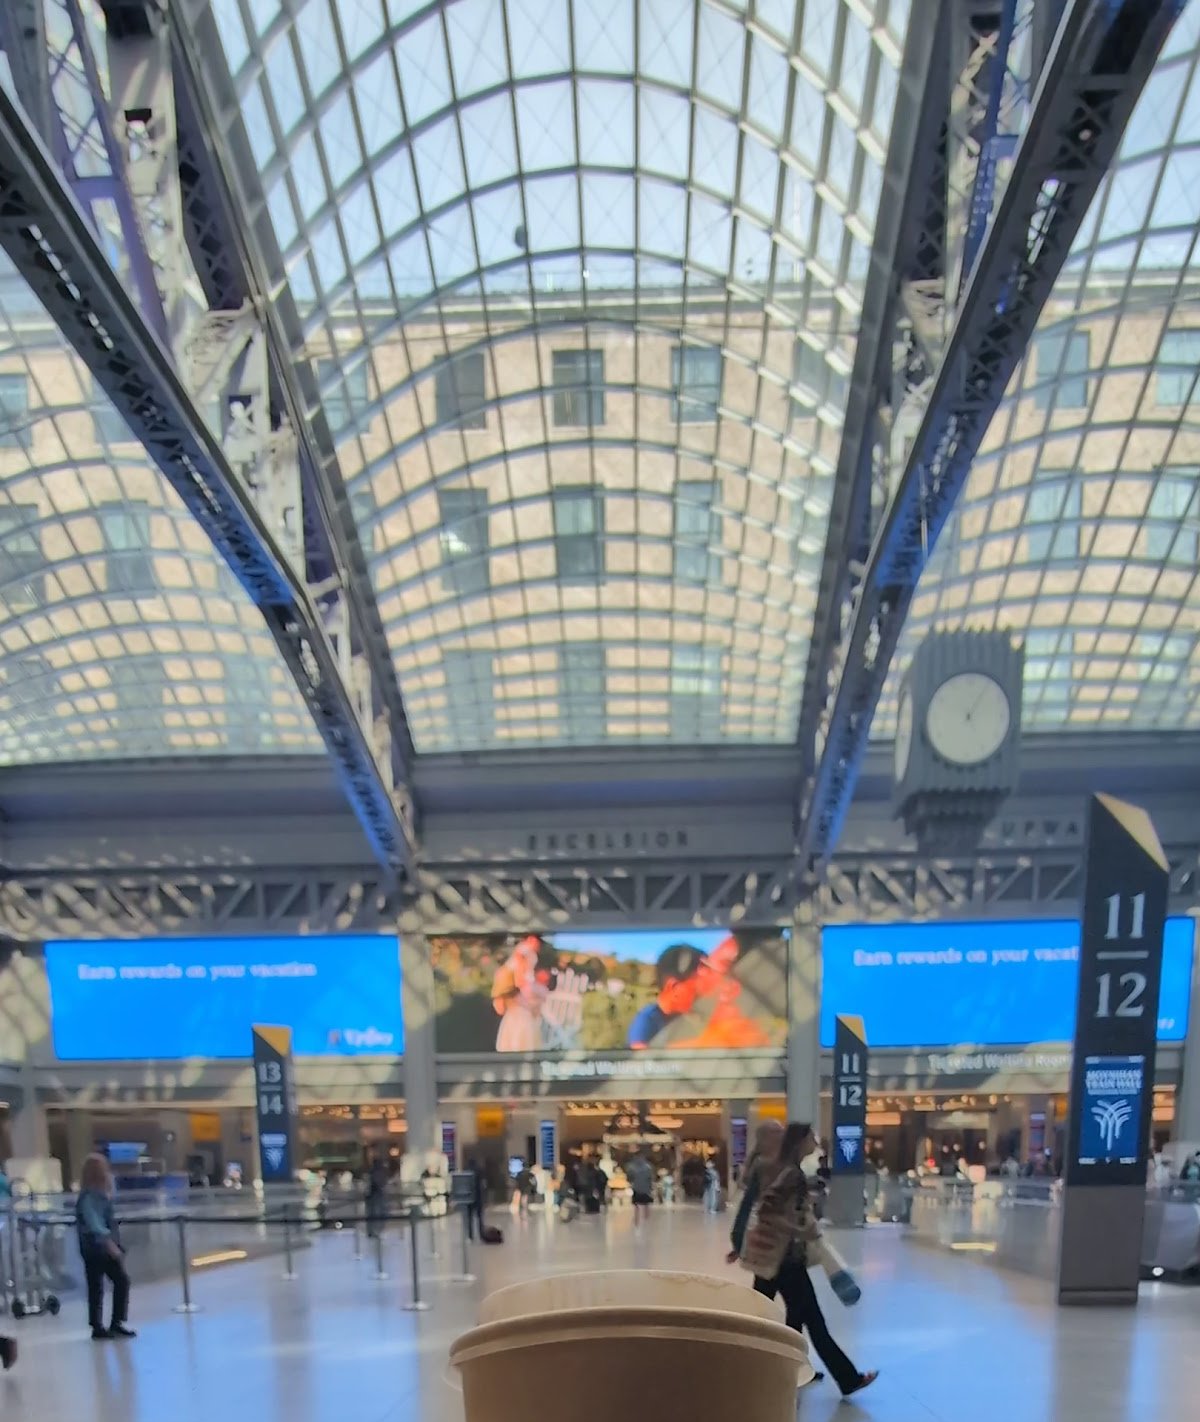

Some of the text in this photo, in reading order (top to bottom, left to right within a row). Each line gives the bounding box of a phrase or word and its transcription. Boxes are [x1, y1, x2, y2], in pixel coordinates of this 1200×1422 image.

[529, 830, 689, 849] EXCELSIOR
[1002, 820, 1079, 838] UPWA
[1103, 892, 1145, 939] 11
[853, 946, 1079, 966] Earn rewards on your vacat
[1095, 972, 1147, 1018] 12
[258, 1061, 282, 1083] 13
[842, 1053, 860, 1074] 11
[259, 1094, 284, 1115] 14
[840, 1085, 862, 1106] 12
